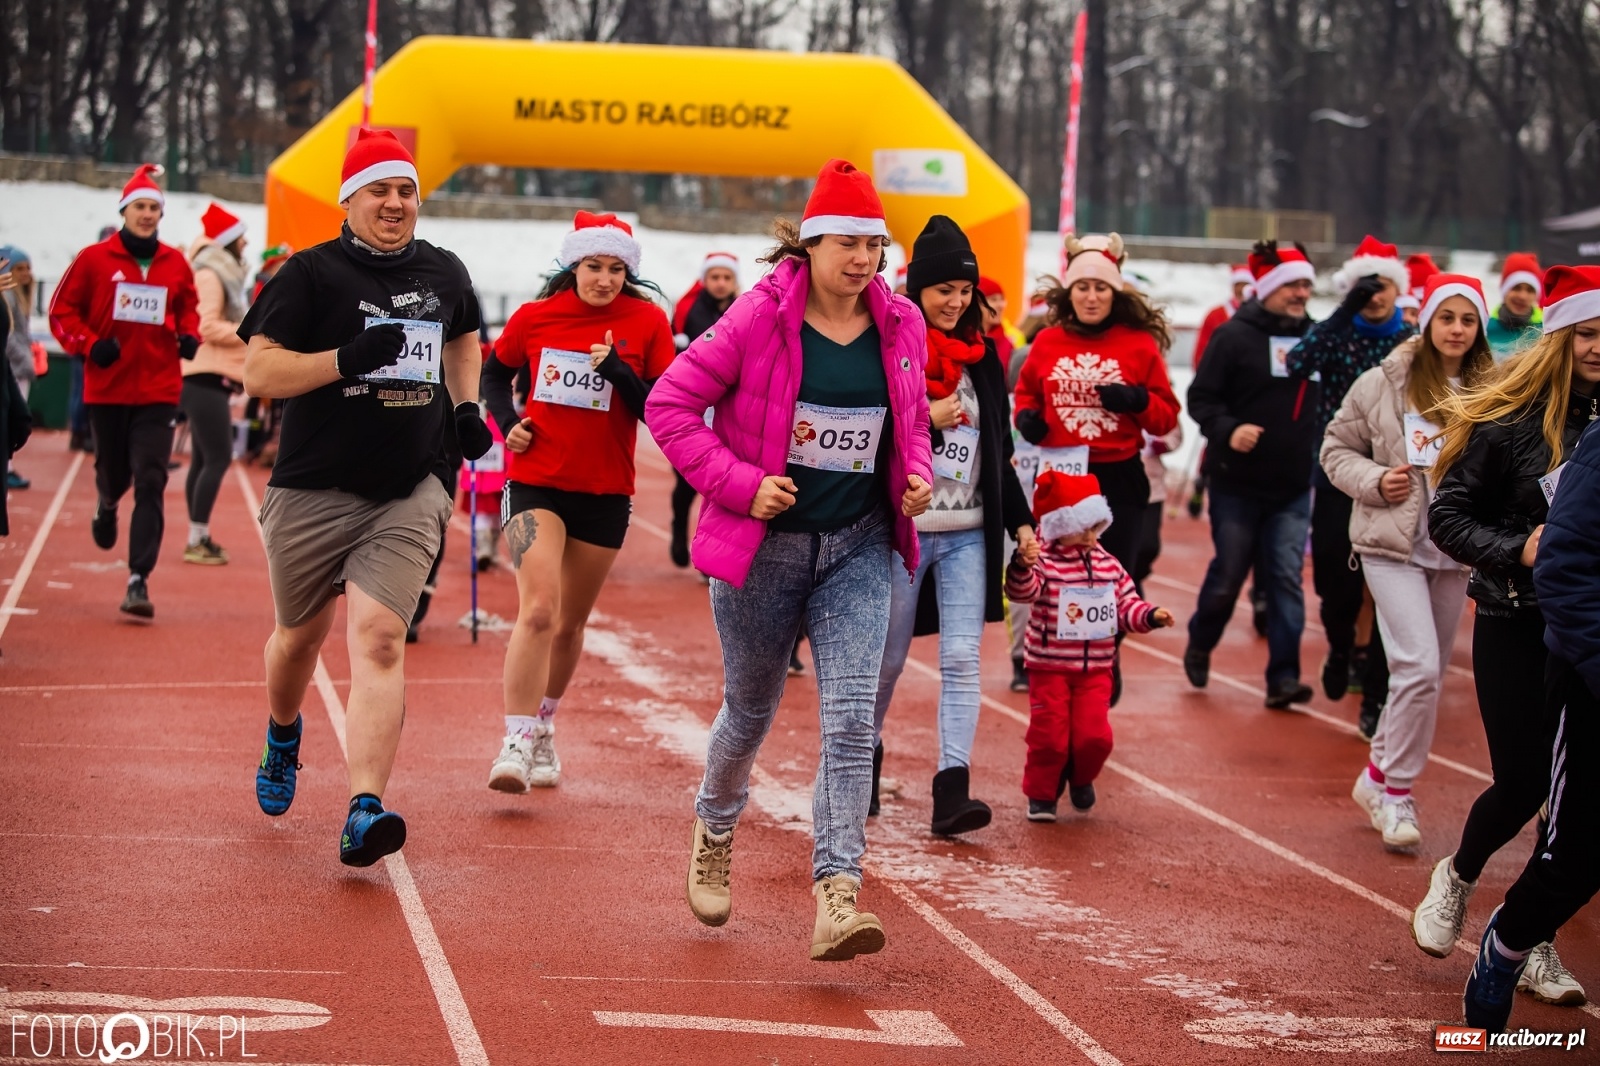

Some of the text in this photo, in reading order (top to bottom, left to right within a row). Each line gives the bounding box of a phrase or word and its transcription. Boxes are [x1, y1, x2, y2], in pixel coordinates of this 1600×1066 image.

[514, 98, 790, 130] MIASTO RACIBÓRZ
[133, 296, 158, 312] 013
[391, 291, 422, 308] ROCK
[563, 370, 605, 392] 049
[1057, 379, 1099, 394] HAPP
[1051, 392, 1103, 407] HOLIDA
[819, 429, 871, 451] 053
[1086, 602, 1115, 623] 086
